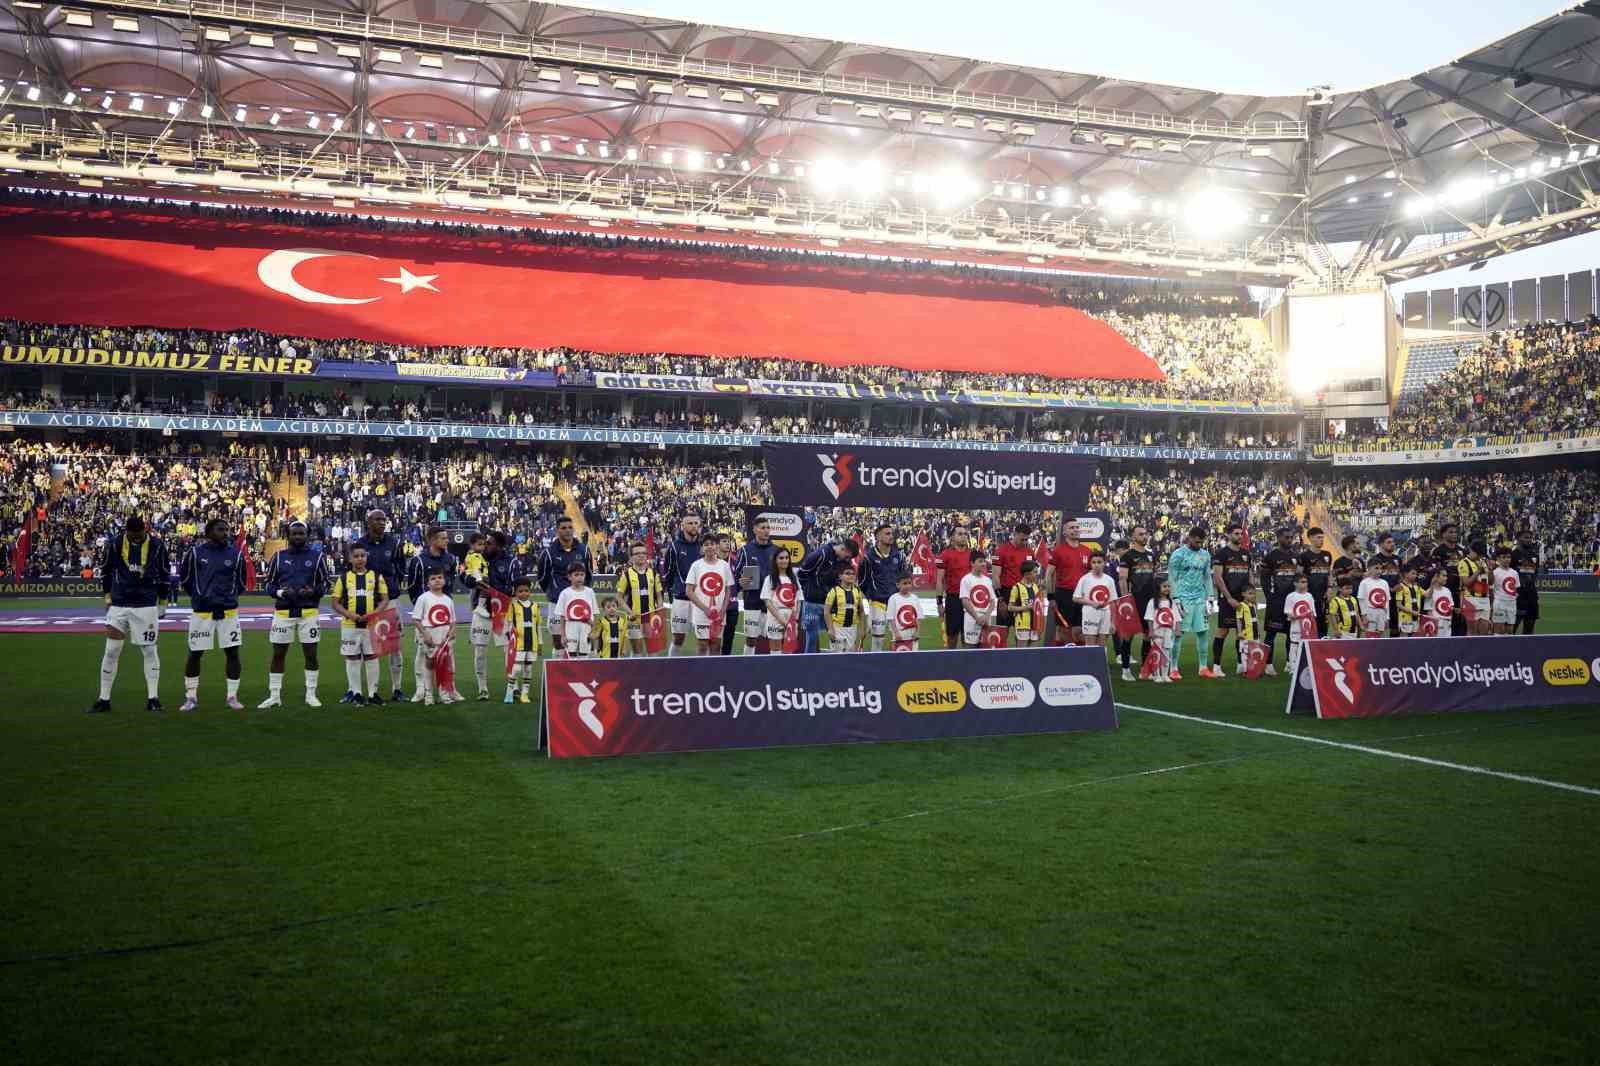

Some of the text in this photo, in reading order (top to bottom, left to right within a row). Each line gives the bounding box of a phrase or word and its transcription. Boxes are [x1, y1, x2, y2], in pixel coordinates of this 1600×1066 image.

[3, 346, 313, 374] UMUDUMUZ FENER
[858, 463, 969, 494] trendyol
[143, 631, 156, 642] 19
[980, 681, 1025, 693] trendyol
[1367, 661, 1461, 688] trendyol
[630, 683, 773, 719] trendyol
